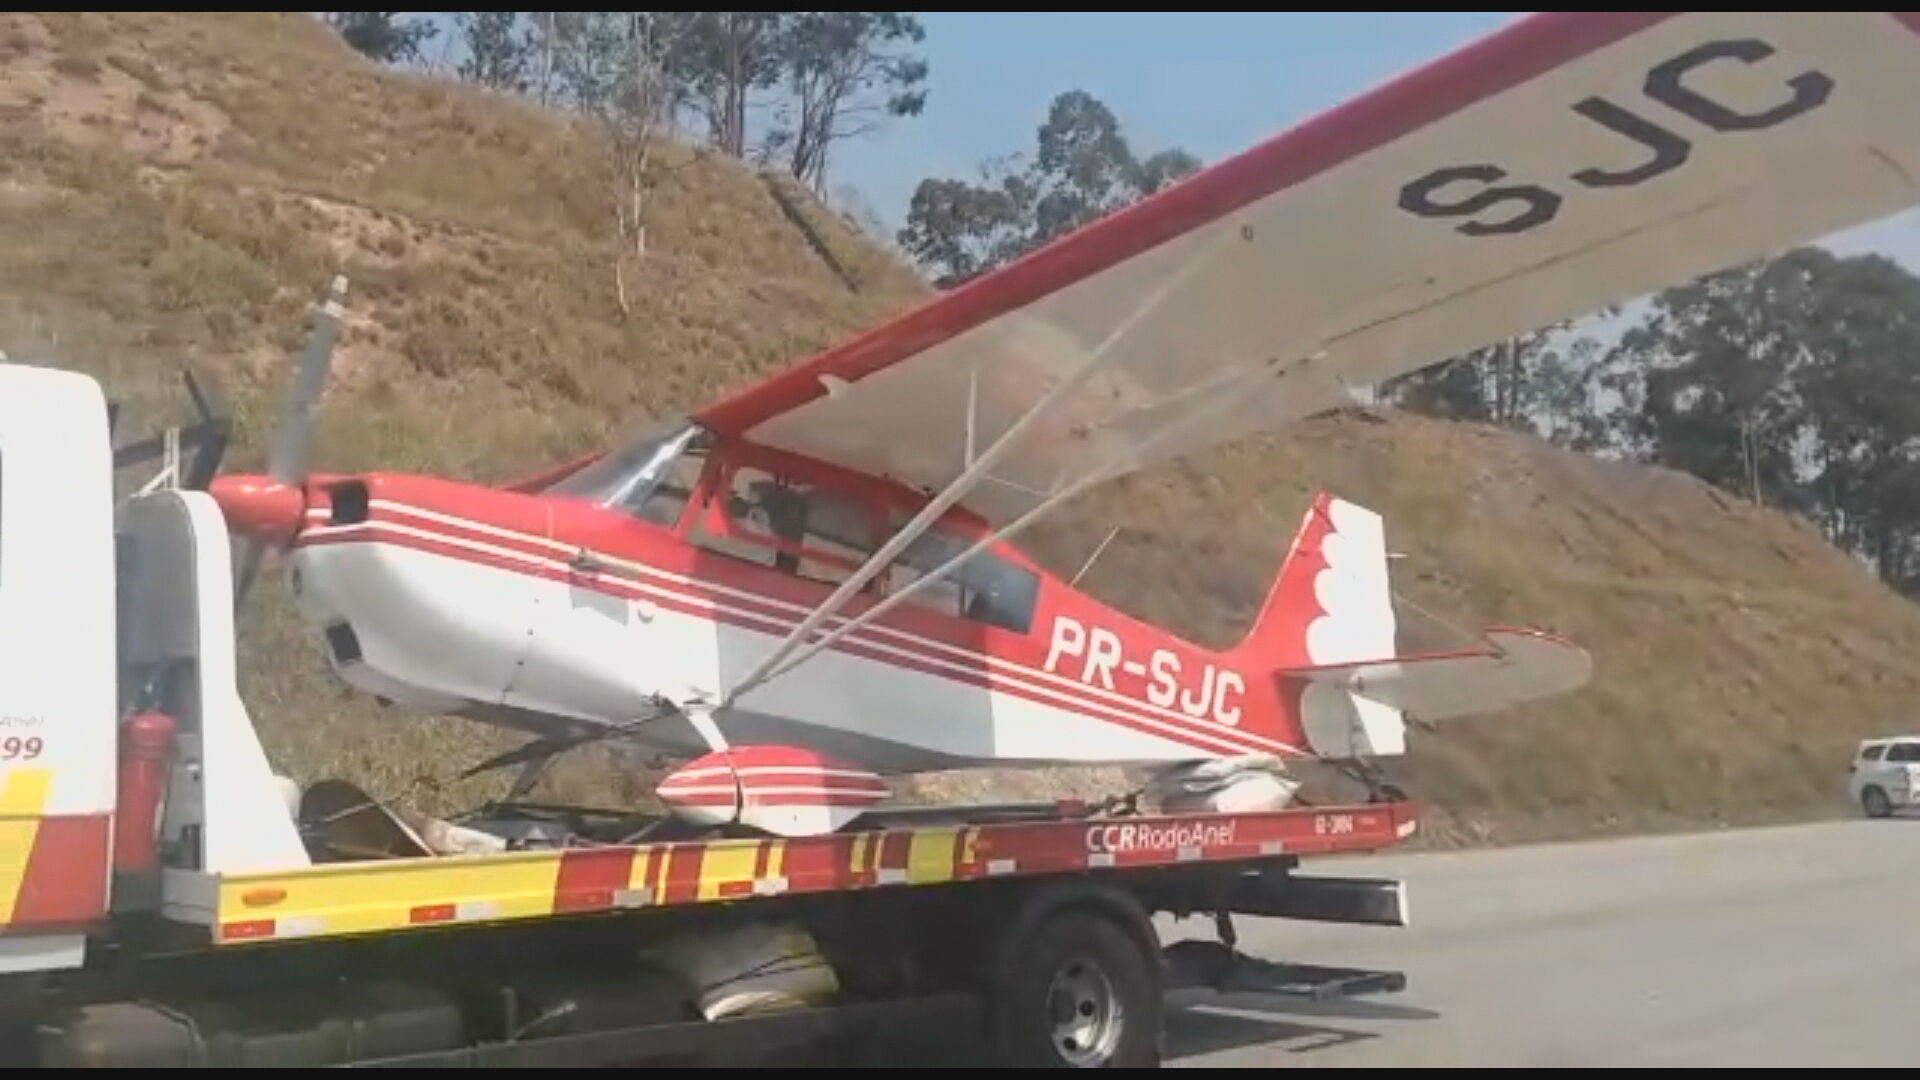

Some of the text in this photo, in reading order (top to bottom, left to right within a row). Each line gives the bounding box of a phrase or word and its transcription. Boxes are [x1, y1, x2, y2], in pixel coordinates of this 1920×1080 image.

[1397, 38, 1835, 237] SJC
[1043, 615, 1246, 727] PR-SJC
[0, 736, 44, 761] 99
